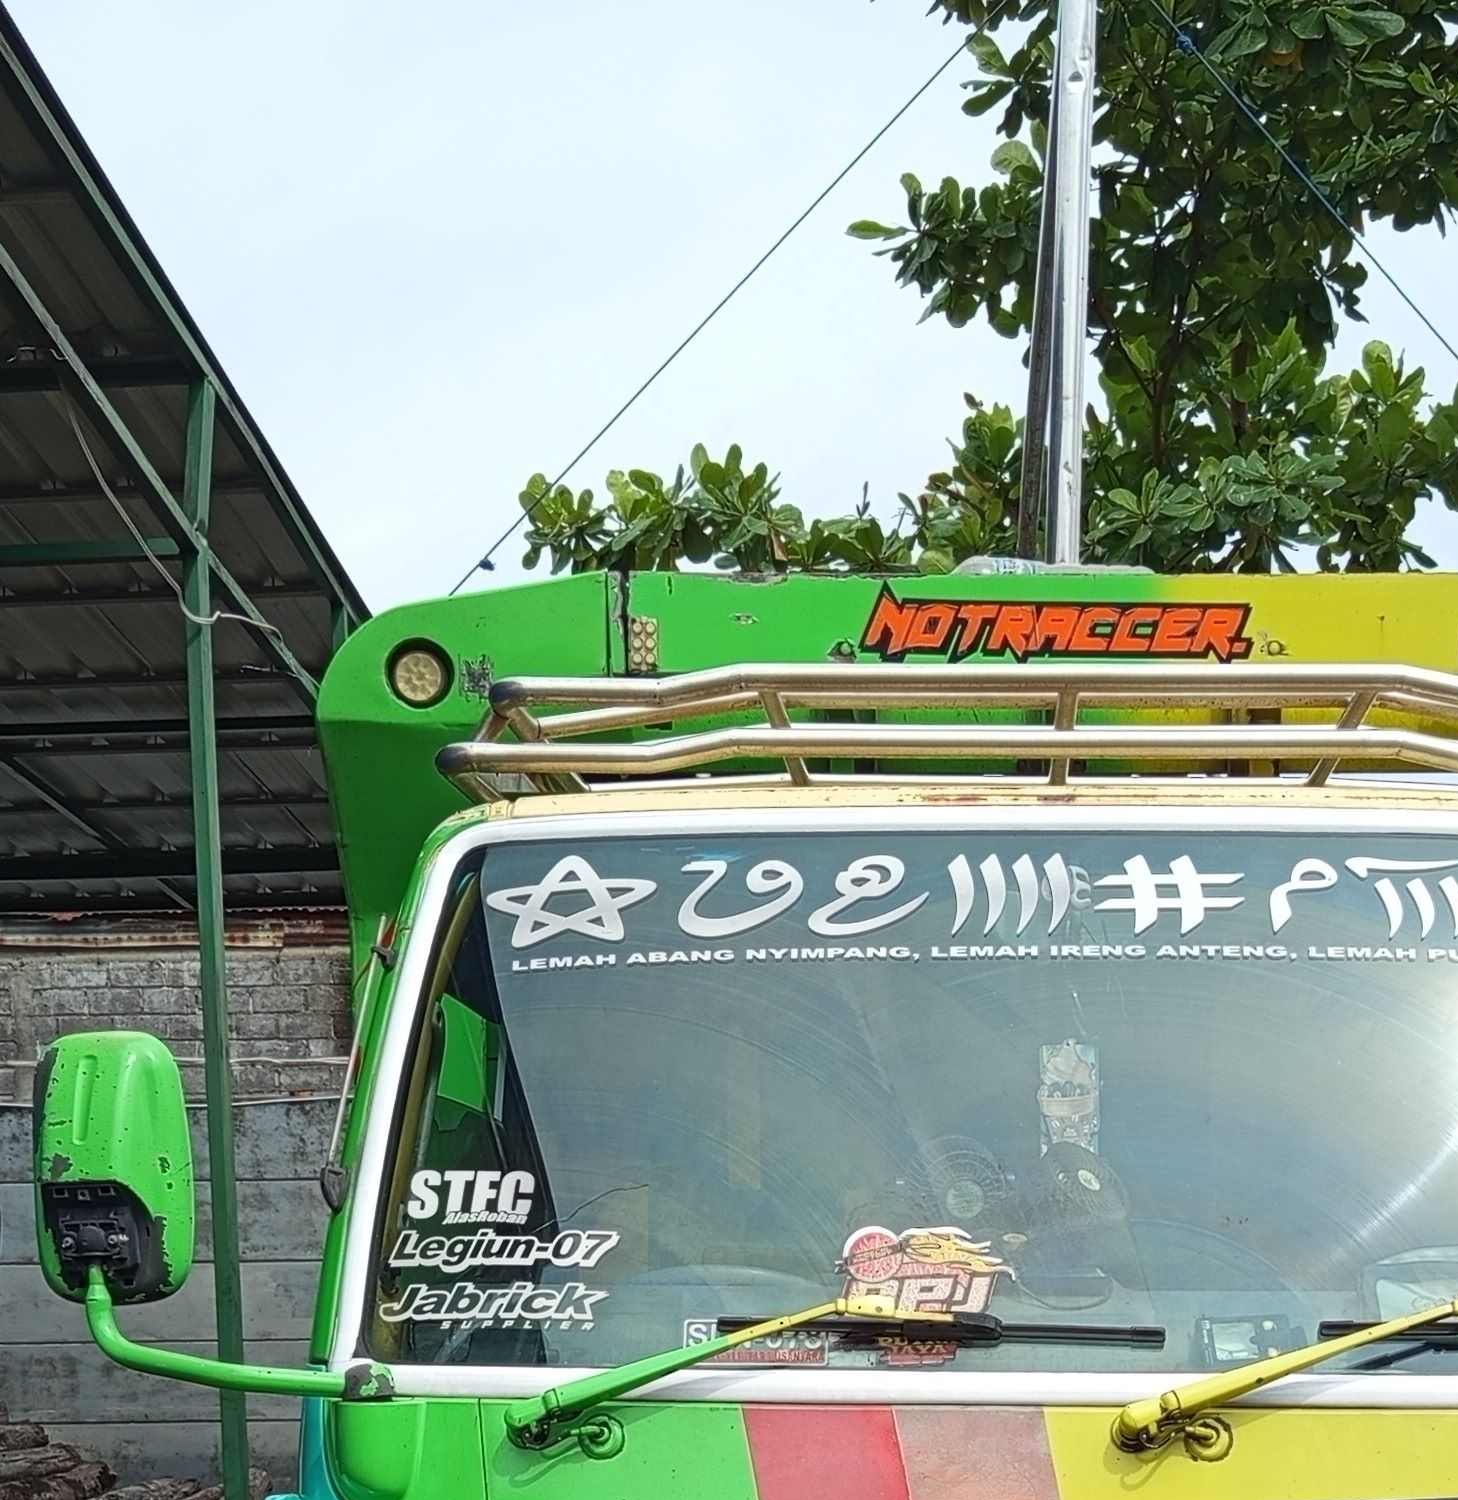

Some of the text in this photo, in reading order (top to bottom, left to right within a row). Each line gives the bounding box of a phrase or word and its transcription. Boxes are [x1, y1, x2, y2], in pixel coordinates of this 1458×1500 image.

[511, 954, 616, 971] LEMAH
[626, 950, 735, 964] ABANG
[746, 946, 920, 962] NYIMPANG,
[931, 945, 1039, 959] LEMAH
[1050, 945, 1146, 959] IRENG
[1156, 945, 1297, 961] ANTENG,
[1309, 946, 1417, 962] LEMAH
[407, 1169, 535, 1220] STFC
[388, 1228, 621, 1274] Legiun-07
[379, 1281, 610, 1323] Jabrick
[439, 1319, 596, 1330] SUPPLIER
